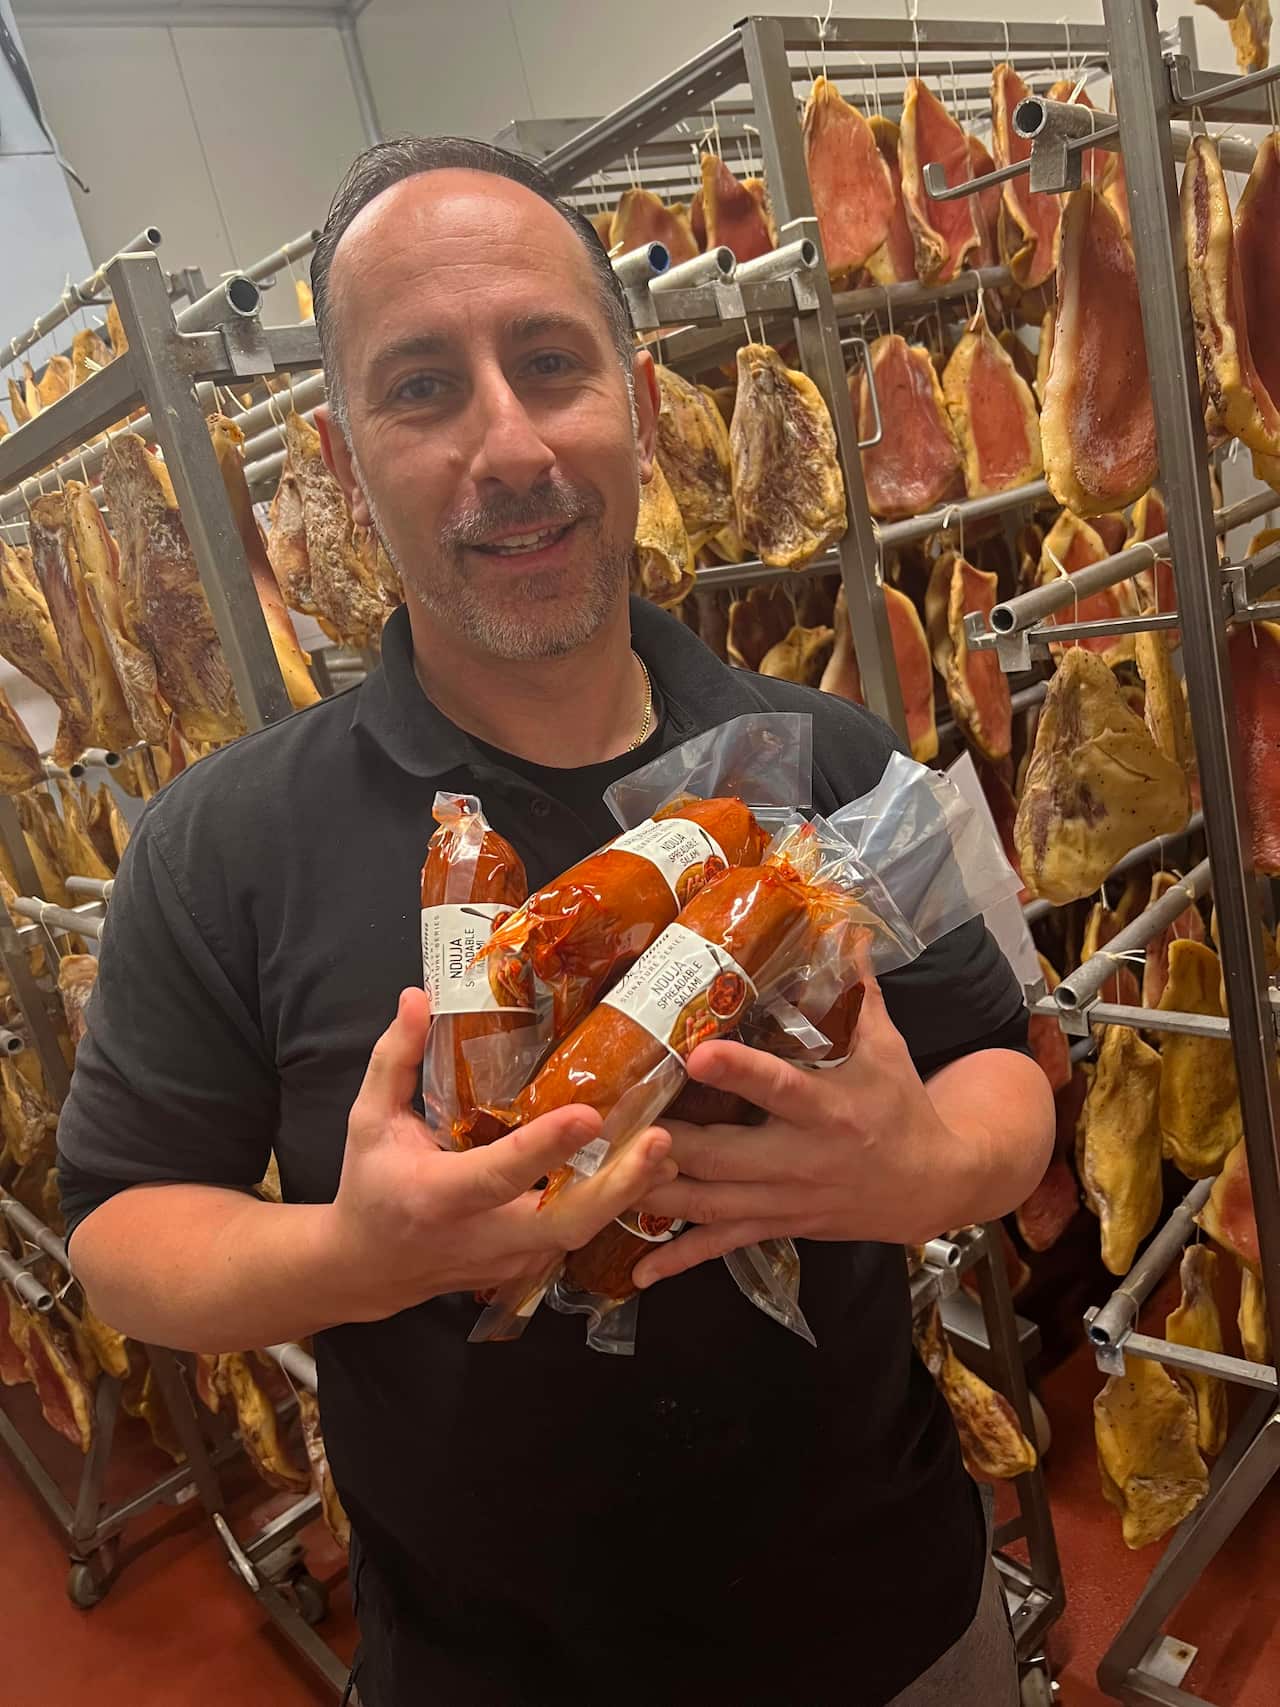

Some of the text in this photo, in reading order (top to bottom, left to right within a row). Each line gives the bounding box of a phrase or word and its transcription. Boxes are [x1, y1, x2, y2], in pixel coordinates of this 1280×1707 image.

[660, 832, 687, 851] NDUJA
[669, 838, 699, 863] SPREADABLE
[680, 849, 700, 866] SALAMI
[450, 938, 463, 979] NDUJA
[464, 928, 475, 988] SEADABLE
[620, 962, 658, 1002] SIGNATURE
[660, 934, 686, 960] SERIES
[651, 961, 689, 995] NDUJA
[657, 960, 703, 1010] SPREADABLE
[674, 976, 703, 1007] SALAMI
